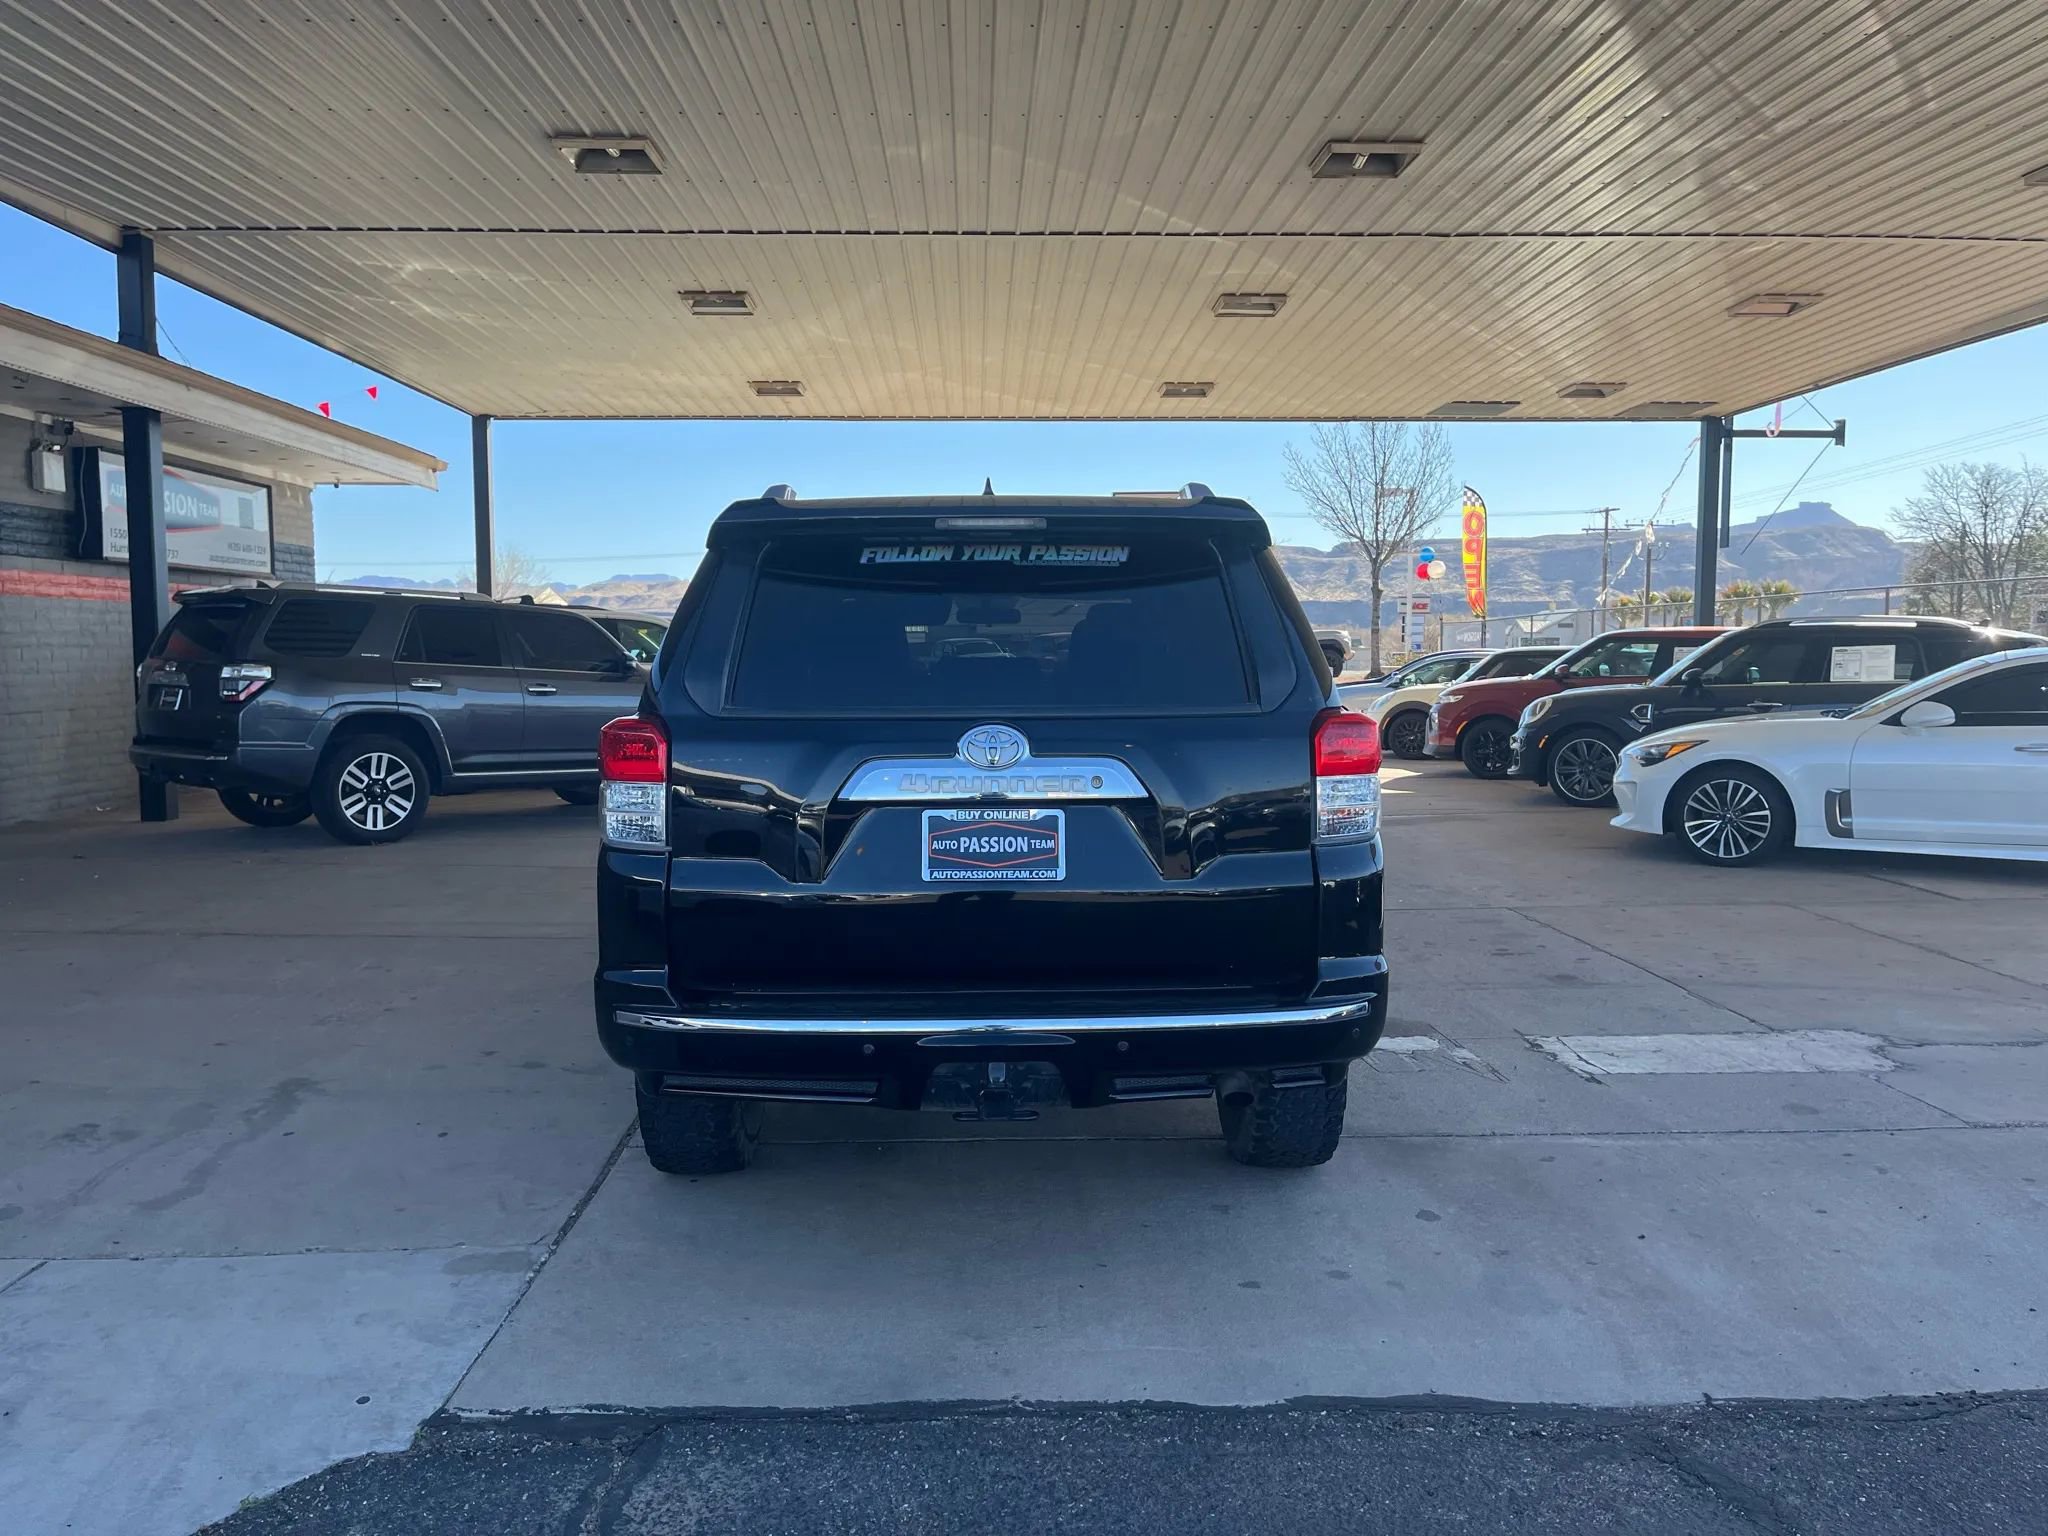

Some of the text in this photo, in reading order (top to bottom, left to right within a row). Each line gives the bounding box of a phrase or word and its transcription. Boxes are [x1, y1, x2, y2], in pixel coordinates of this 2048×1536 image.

[164, 490, 197, 519] SION
[859, 545, 1130, 564] FOLLOW YOUR PASSION
[898, 773, 1088, 793] 4RUNNER
[957, 810, 1029, 820] BUY ONLINE
[931, 836, 1055, 853] AUTO PASSION TEAM
[931, 870, 1056, 879] AUTOPASSIONTEAM.COM
